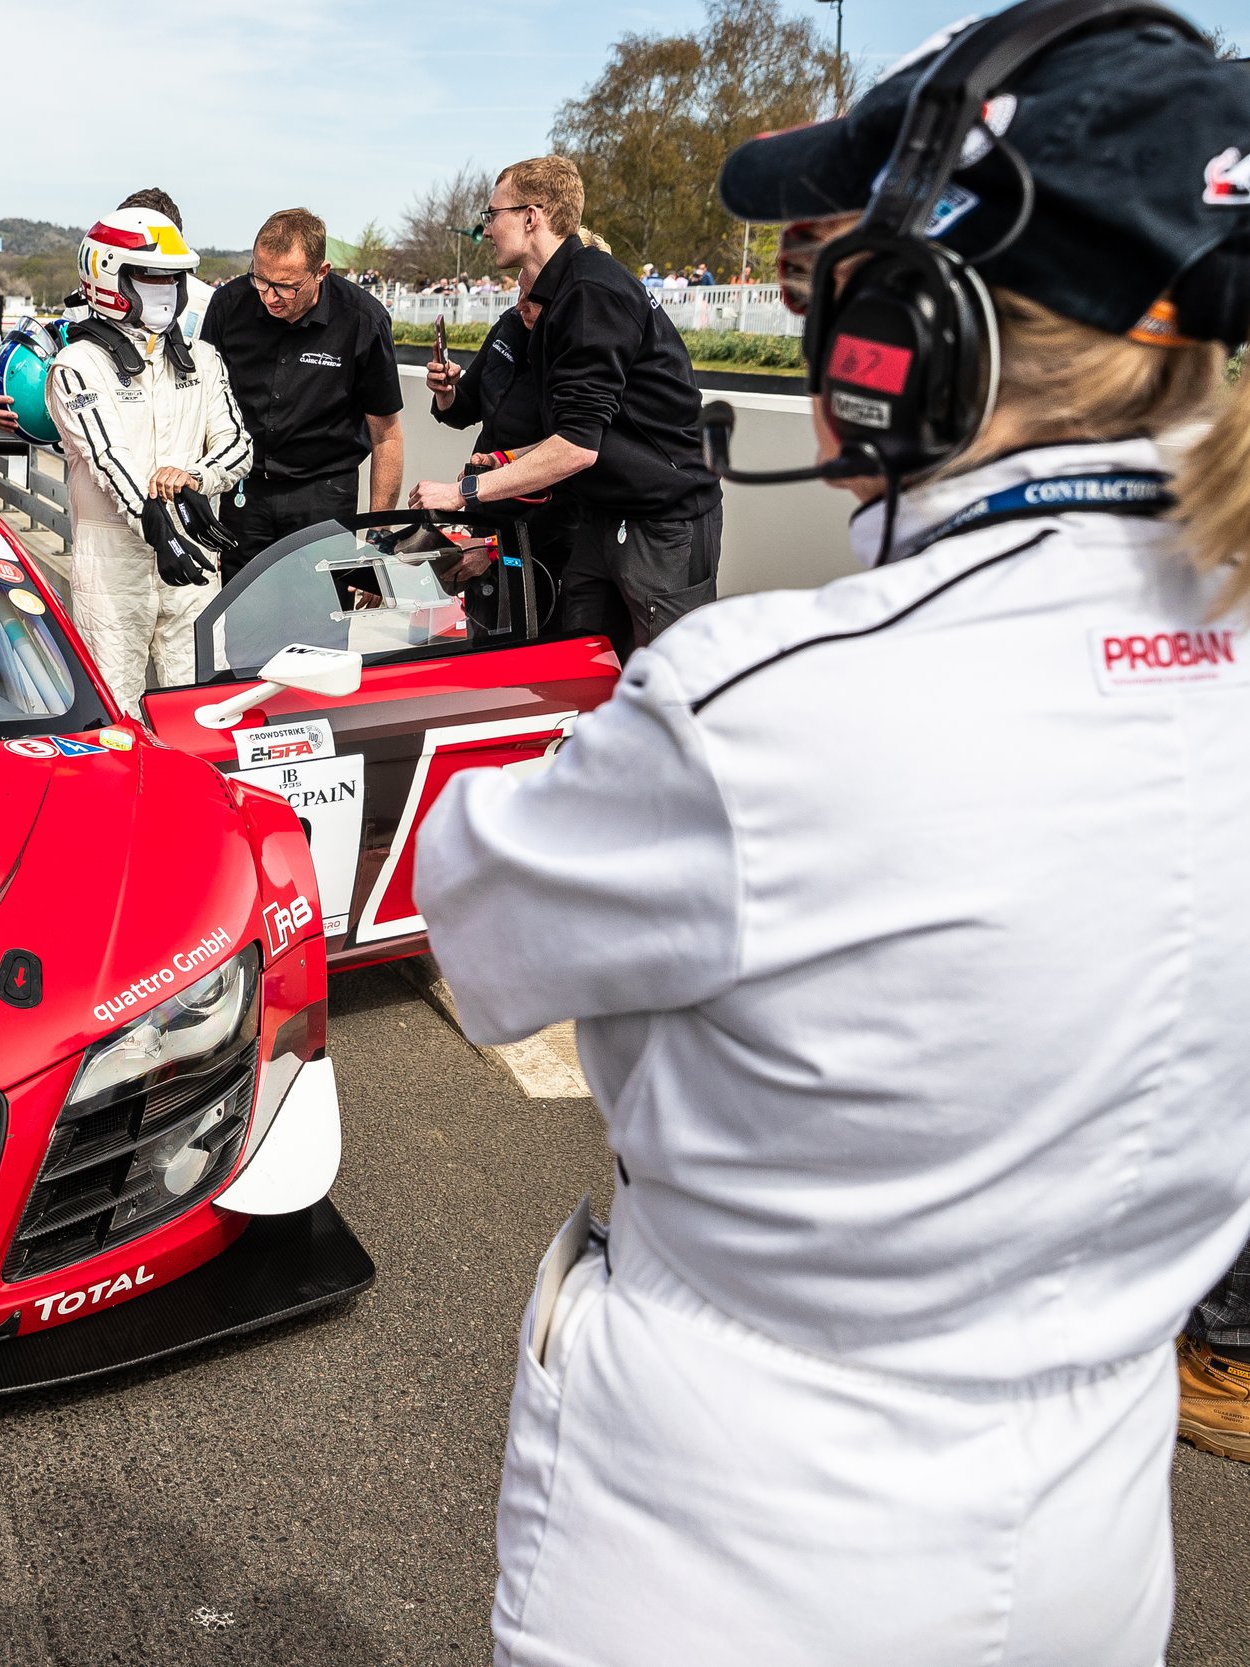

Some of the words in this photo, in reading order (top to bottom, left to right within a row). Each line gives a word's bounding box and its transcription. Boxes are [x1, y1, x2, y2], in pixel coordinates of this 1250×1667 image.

[286, 647, 348, 657] WRT
[1104, 630, 1234, 671] PROBAN
[18, 743, 47, 754] E
[250, 728, 306, 741] CROWDSTRIKE
[275, 895, 313, 943] R8
[93, 968, 174, 1022] quattro
[173, 927, 232, 972] GmbH
[34, 1265, 155, 1321] TOTAL
